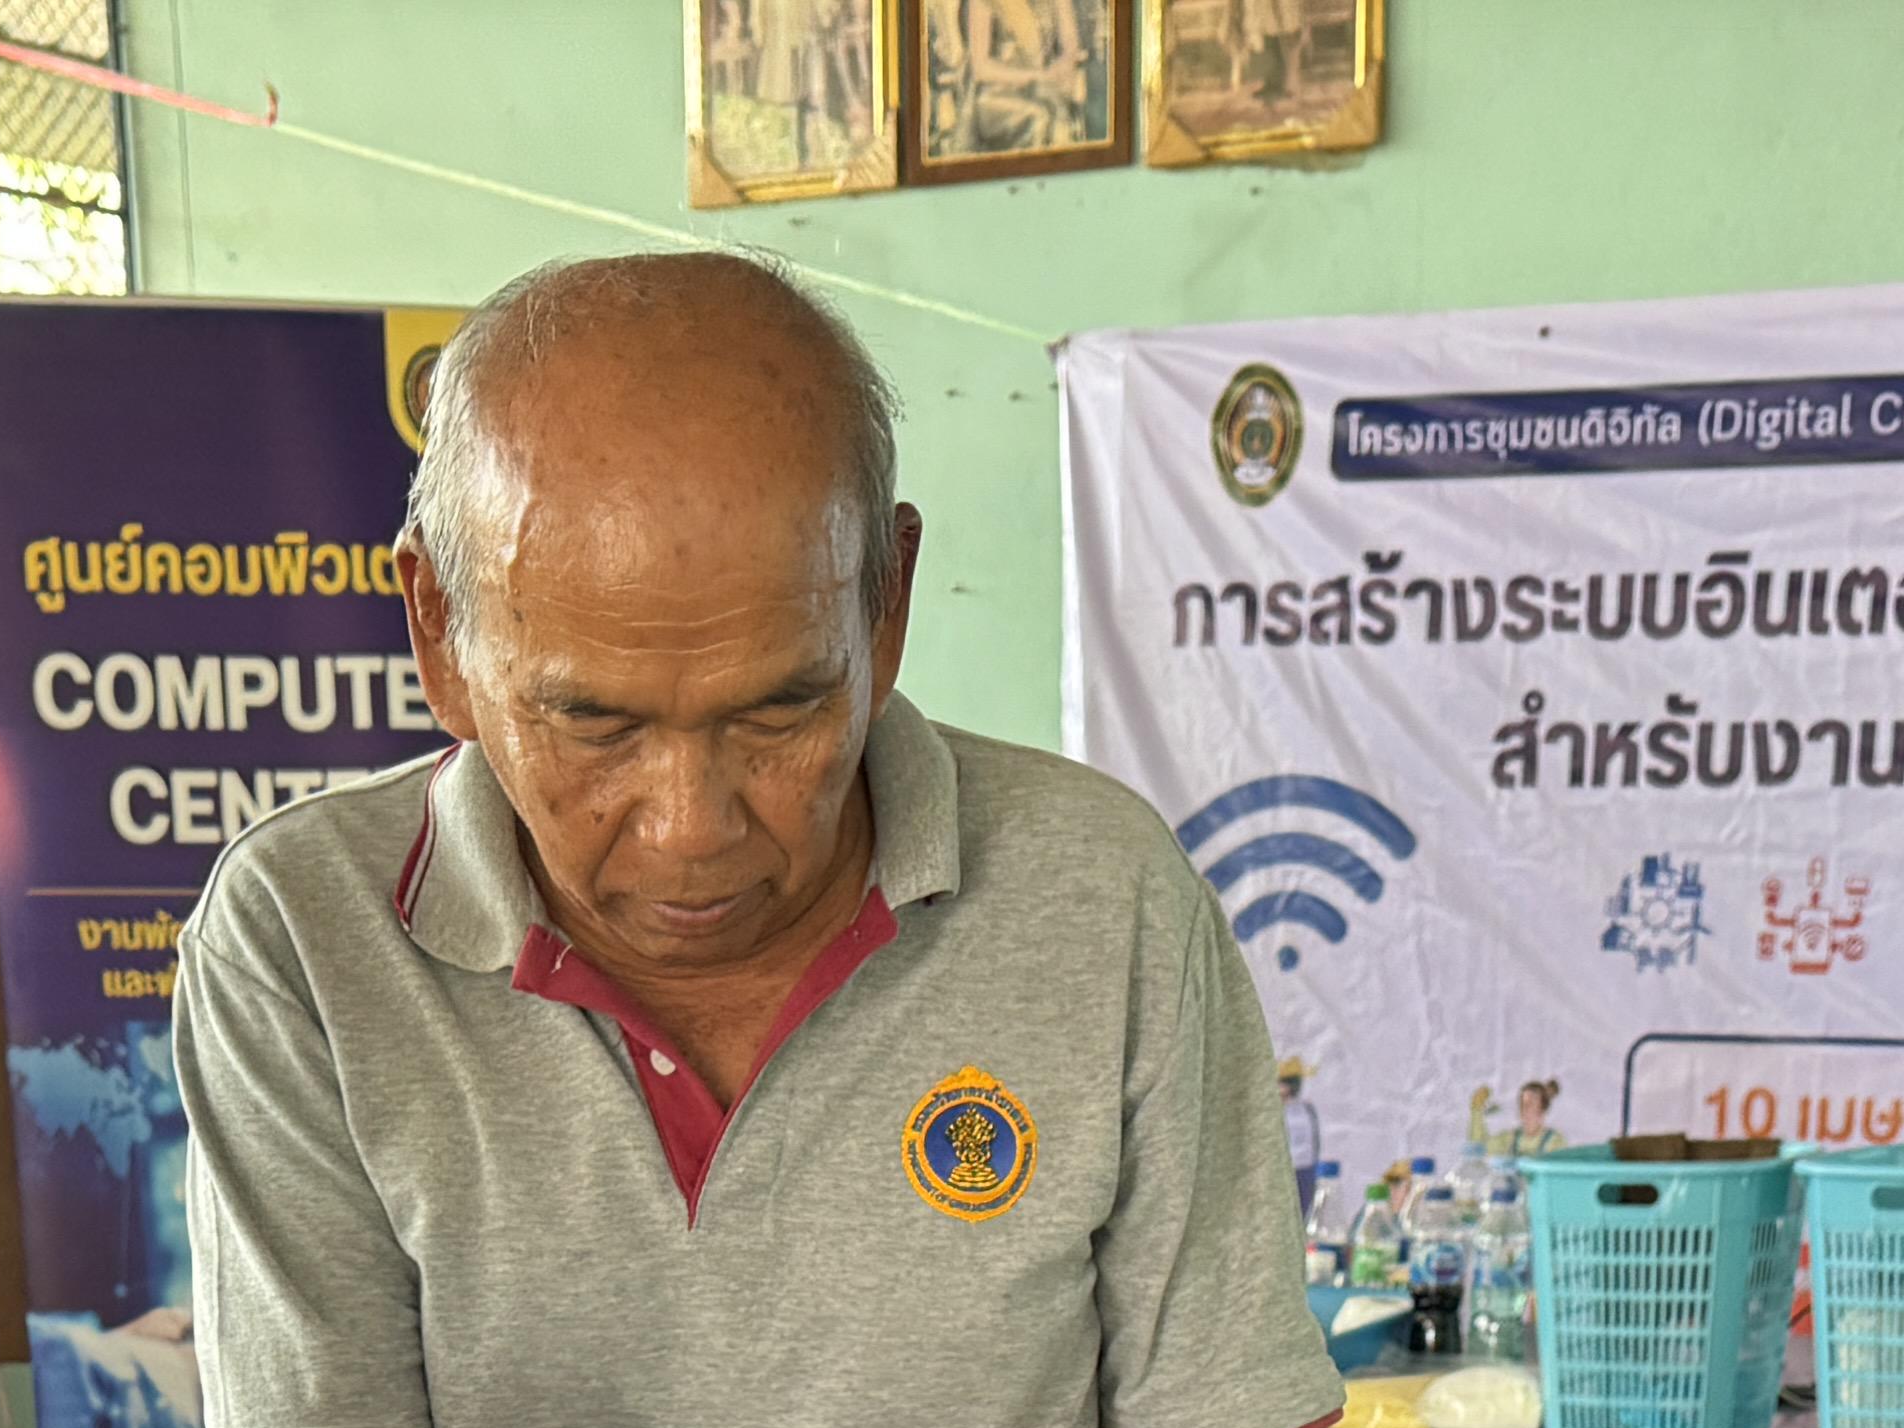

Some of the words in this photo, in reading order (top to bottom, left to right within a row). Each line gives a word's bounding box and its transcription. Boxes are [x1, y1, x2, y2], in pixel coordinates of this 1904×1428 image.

[1347, 403, 1682, 462] โครงการชุมชนดิจิทัล
[1698, 393, 1853, 452] (Digital
[33, 652, 438, 732] COMPUTE
[1704, 1086, 1776, 1142] 10
